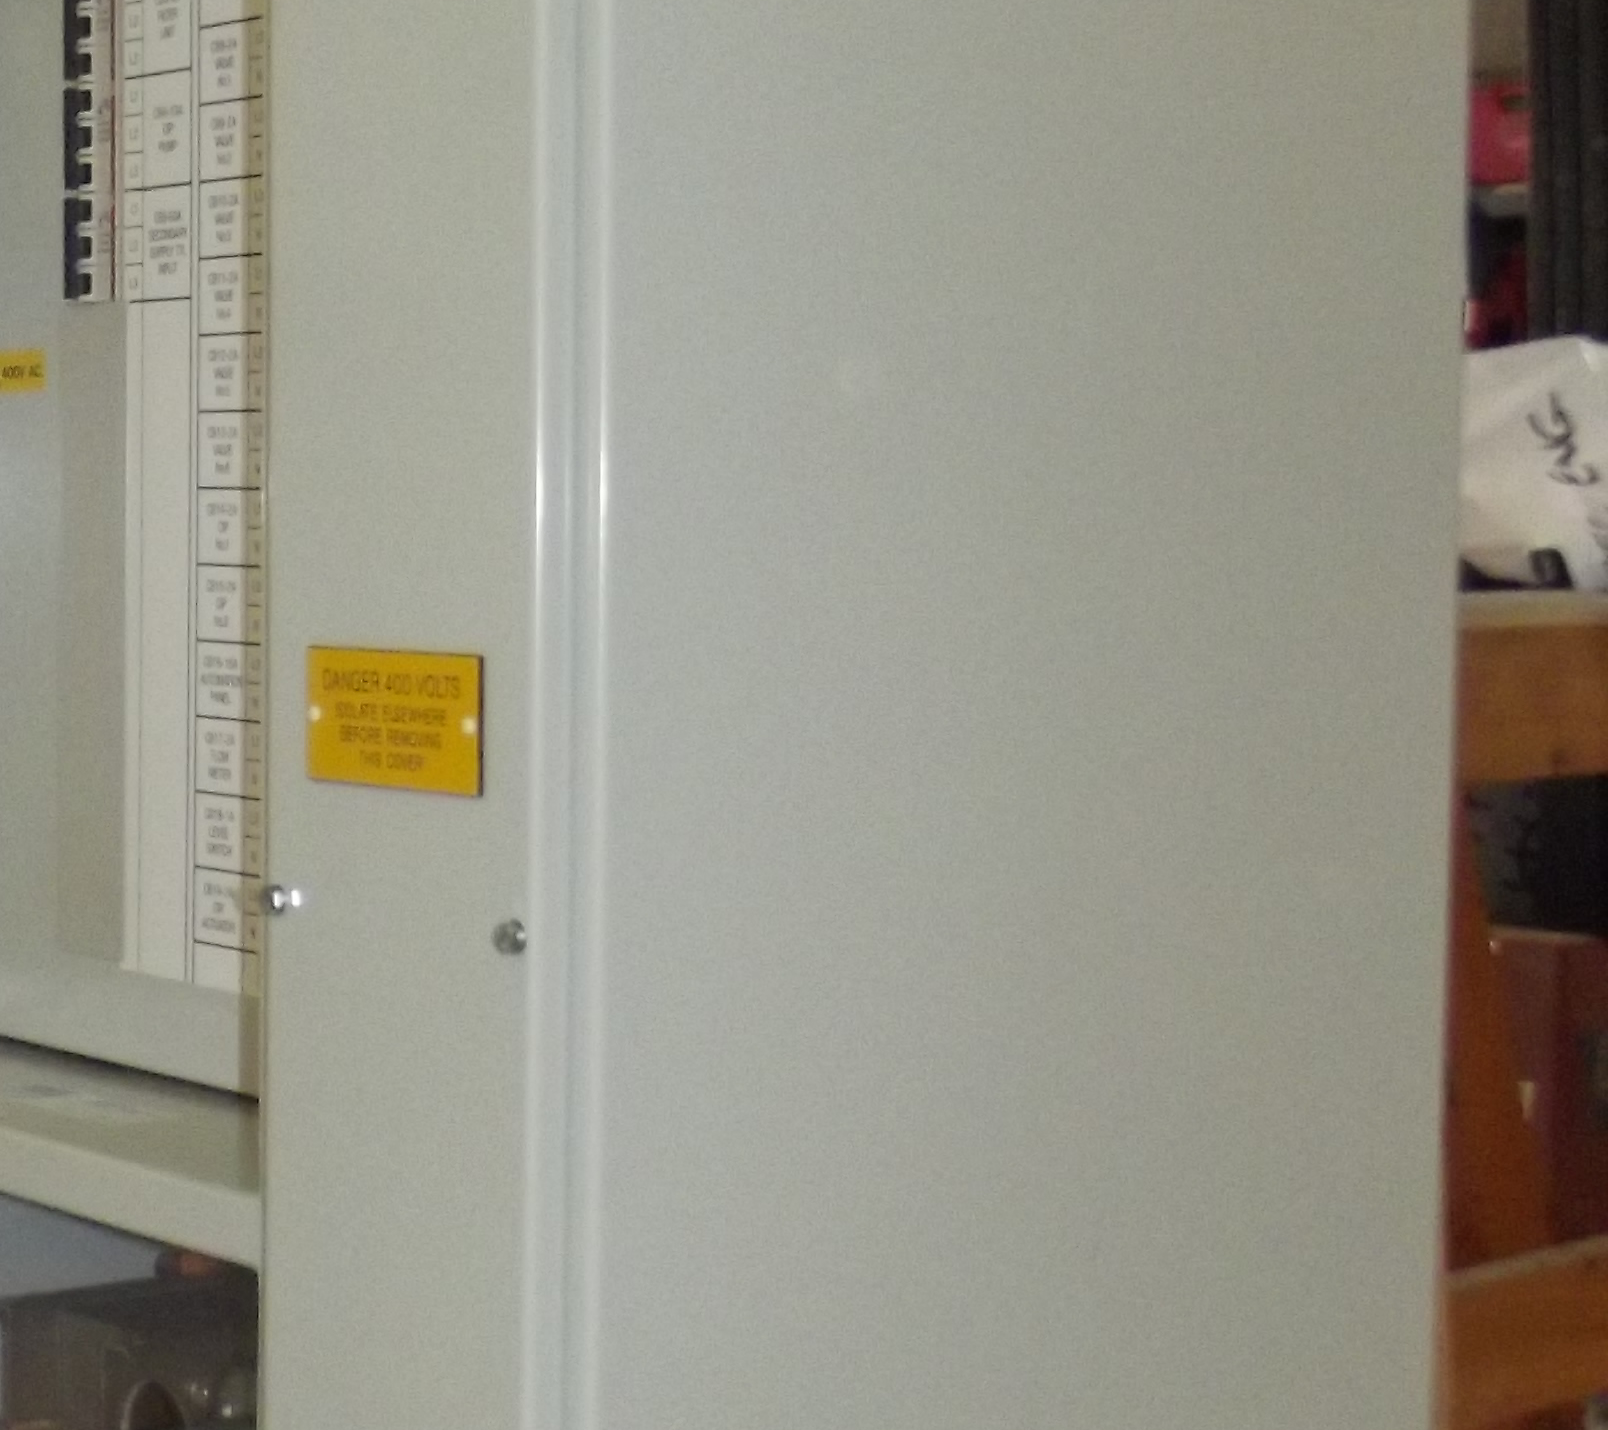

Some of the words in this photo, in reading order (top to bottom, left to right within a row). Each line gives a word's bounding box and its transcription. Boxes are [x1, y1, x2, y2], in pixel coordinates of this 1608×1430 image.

[322, 667, 380, 693] DANGER
[385, 673, 411, 696] 400
[416, 673, 461, 700] VOLTS
